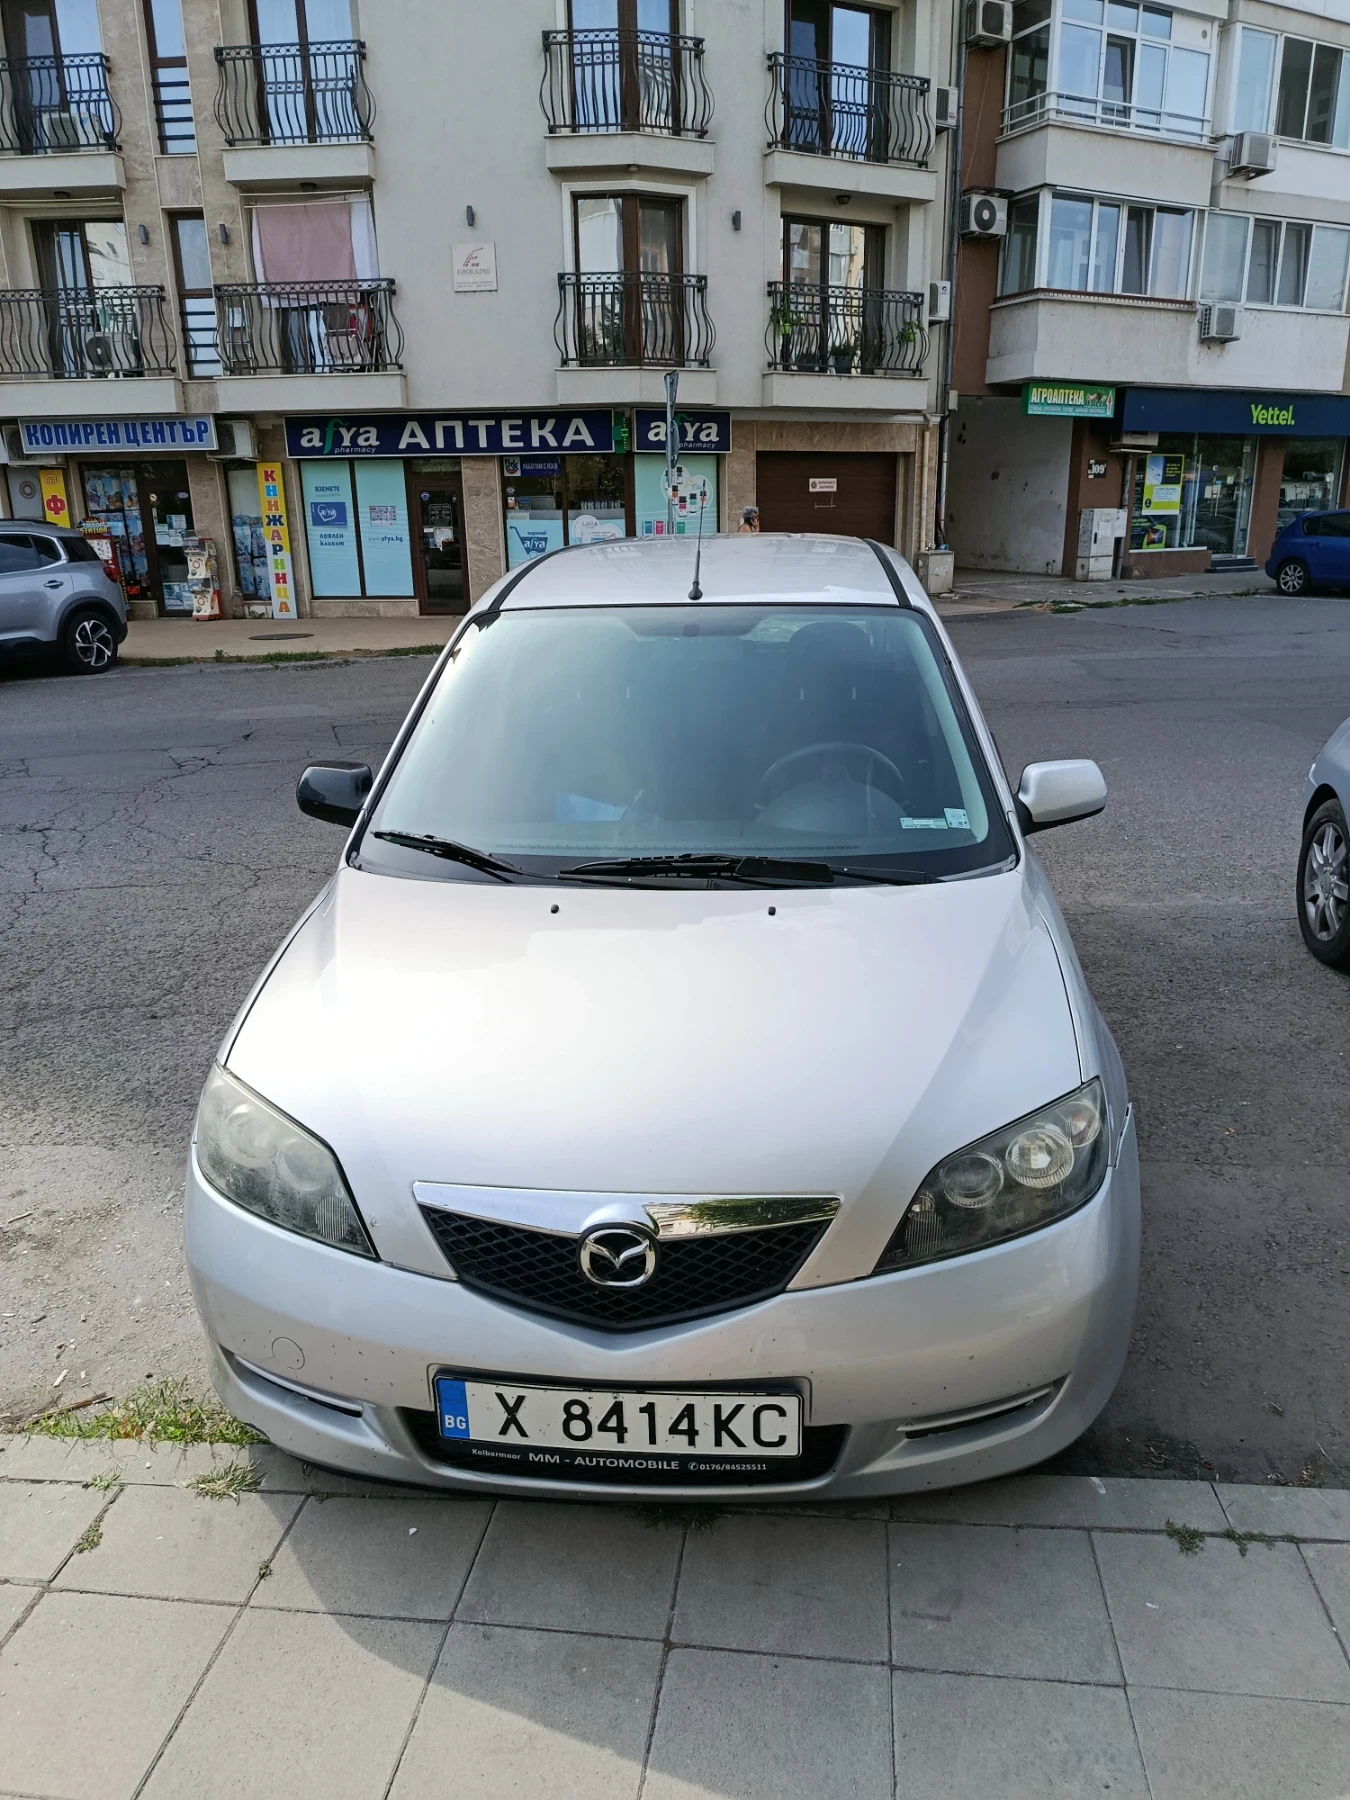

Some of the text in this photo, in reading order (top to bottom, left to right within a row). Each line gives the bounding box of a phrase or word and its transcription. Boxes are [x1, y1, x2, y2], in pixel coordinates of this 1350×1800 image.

[1031, 387, 1085, 405] АГРОАПТЕКА
[1251, 404, 1295, 425] Yettel.
[25, 420, 209, 447] КОПИРЕН ЦЕНТЪР
[300, 418, 596, 454] afya АПТЕКА
[444, 1414, 466, 1430] BG
[495, 1392, 529, 1438] X
[472, 1448, 521, 1460] Kolbermoor
[529, 1452, 560, 1464] MM
[574, 1456, 680, 1470] AUTOMOBILE
[700, 1463, 767, 1471] 0176/84525511
